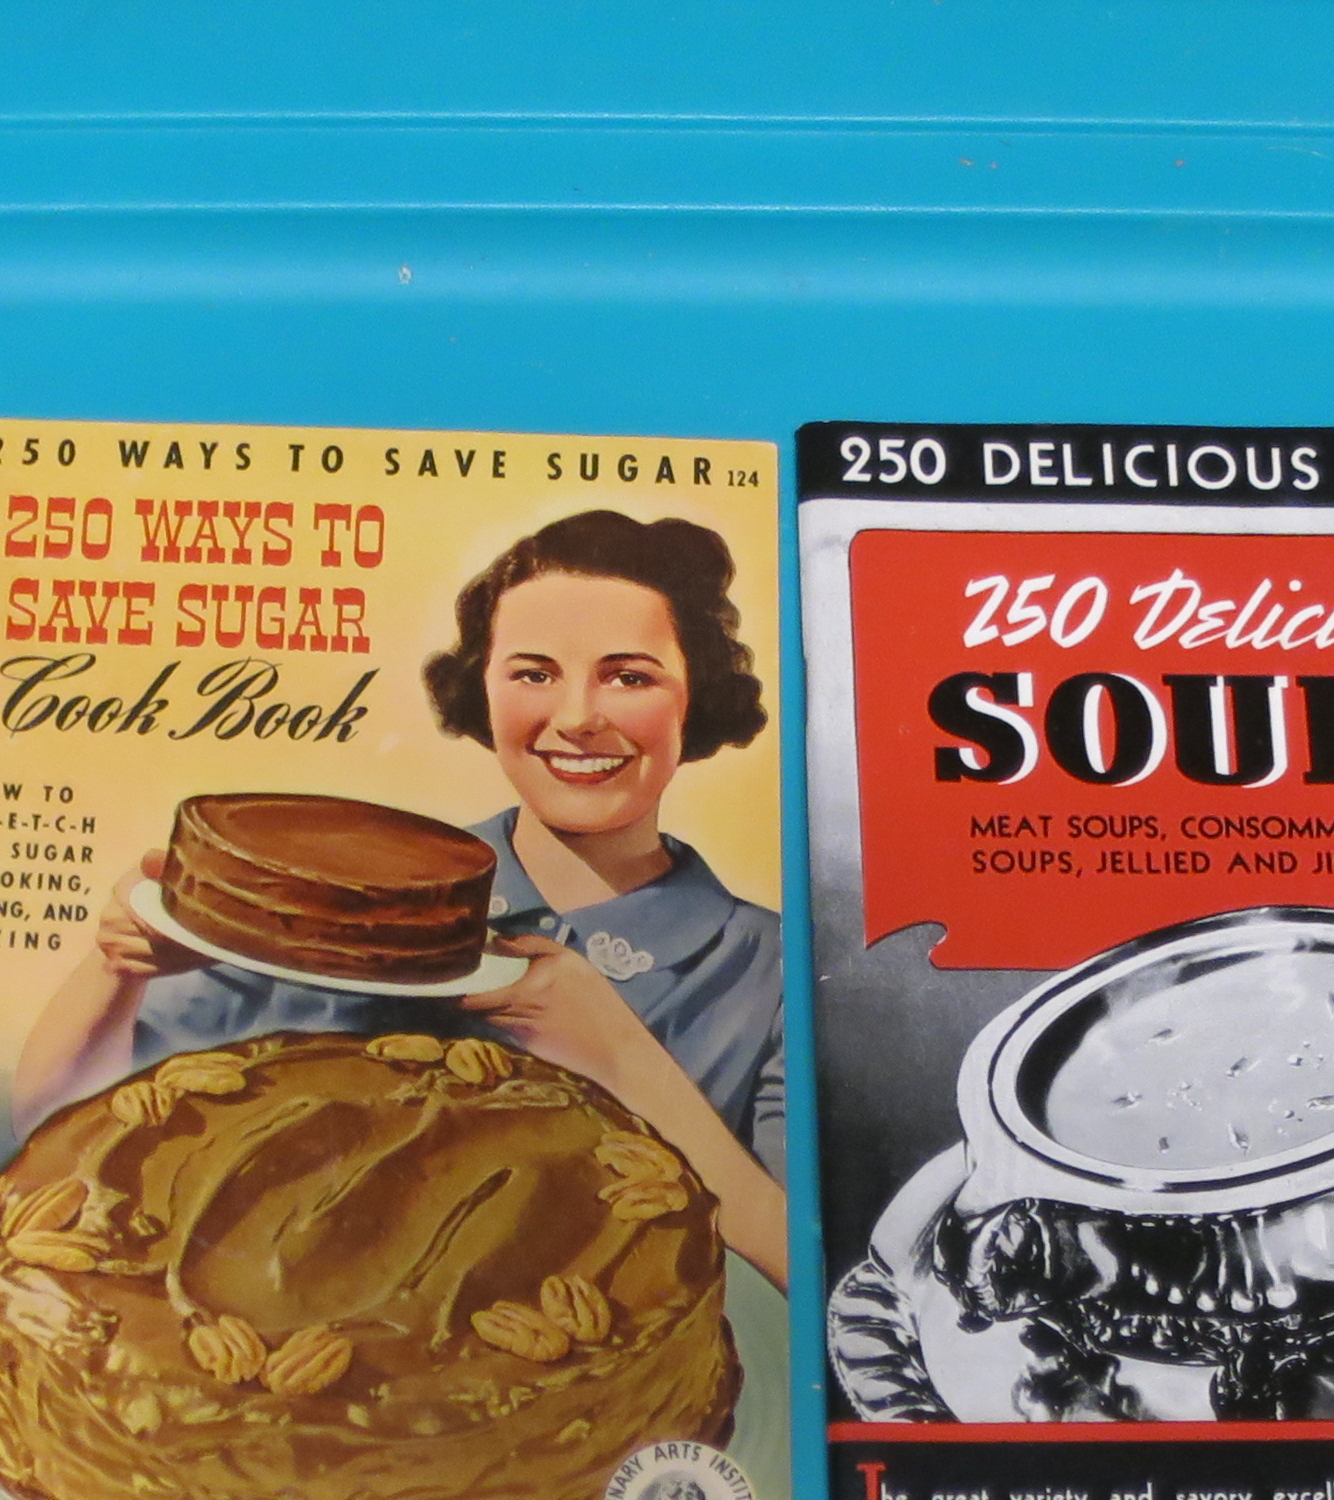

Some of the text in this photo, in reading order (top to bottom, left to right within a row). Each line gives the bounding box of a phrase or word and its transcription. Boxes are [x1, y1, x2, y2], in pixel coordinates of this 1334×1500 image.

[118, 439, 252, 471] WAYS
[288, 443, 345, 473] TO
[384, 447, 507, 479] SAVE
[546, 452, 713, 485] SUGAR
[726, 470, 759, 488] 124
[840, 437, 946, 485] 250
[982, 441, 1320, 490] DELICIOUS
[4, 493, 386, 569] 250 WAYS TO
[5, 576, 371, 654] SAVE SUGAR
[962, 573, 1109, 649] 250
[168, 656, 381, 743] Book
[42, 784, 75, 805] TO
[970, 814, 1054, 841] MEAT
[1066, 814, 1168, 842] SOUPS,
[10, 840, 94, 865] SUGAR
[971, 849, 1084, 878] SOUPS,
[1095, 850, 1212, 876] JELLIED
[1226, 851, 1299, 875] AND
[42, 902, 89, 923] AND
[653, 1442, 703, 1463] ARTS
